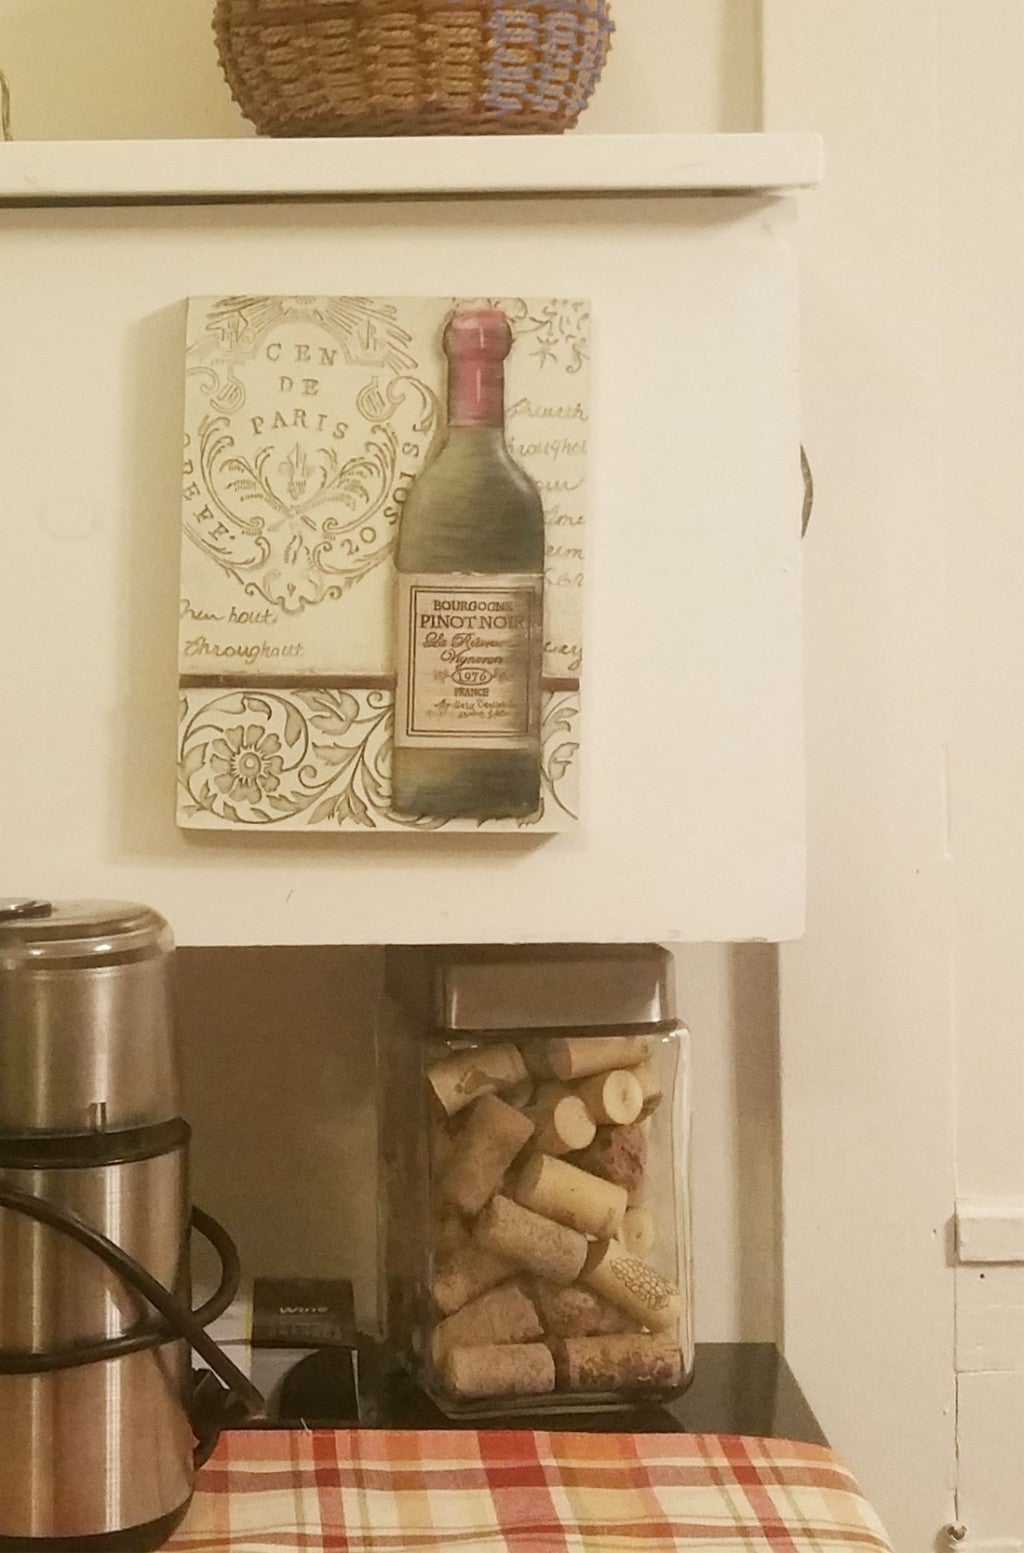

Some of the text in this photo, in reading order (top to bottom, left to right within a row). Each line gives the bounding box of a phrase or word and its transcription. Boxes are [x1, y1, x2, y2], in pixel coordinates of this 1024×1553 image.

[266, 342, 338, 367] CEN
[279, 375, 320, 397] DE
[250, 408, 349, 440] PARIS
[420, 613, 524, 630] PINOT NOIR
[456, 671, 488, 683] 1976
[453, 687, 490, 698] FRANCE
